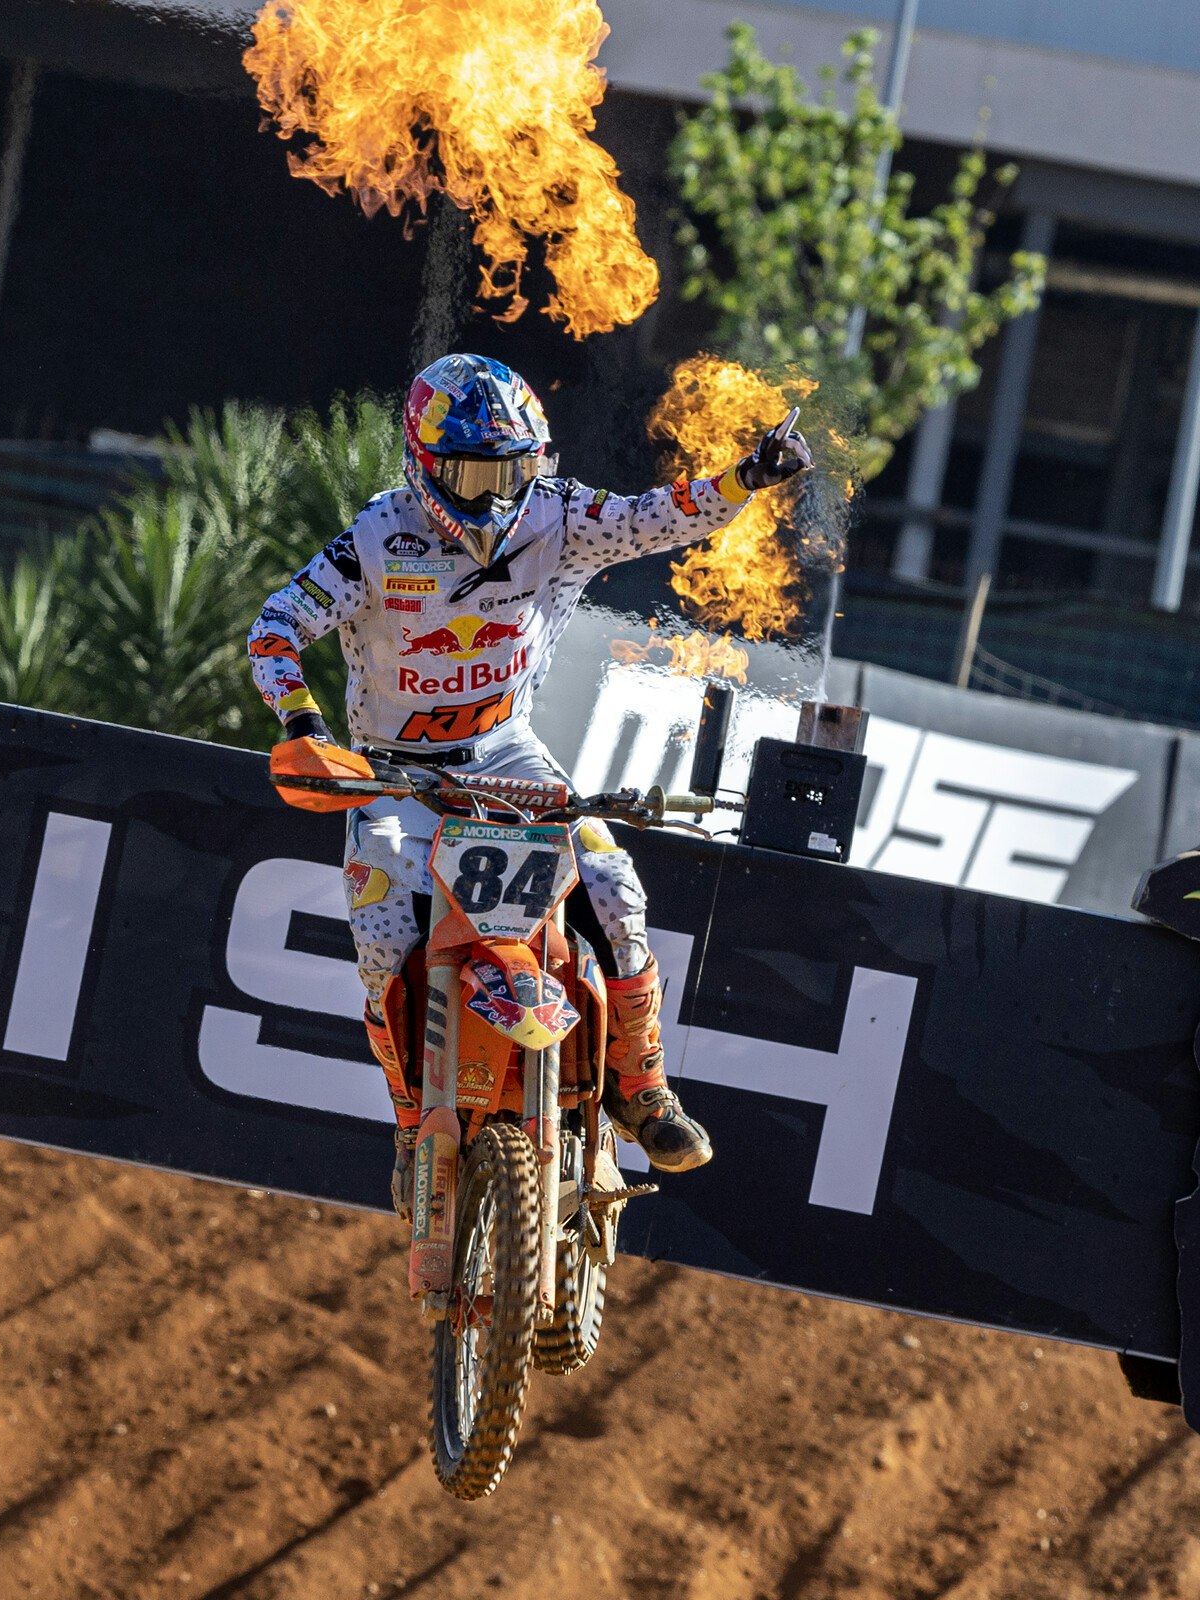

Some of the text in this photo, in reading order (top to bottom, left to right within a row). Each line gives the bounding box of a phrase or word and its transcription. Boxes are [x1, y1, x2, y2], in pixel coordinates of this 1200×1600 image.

[389, 535, 425, 552] Airoh
[401, 560, 453, 573] MOTOREX
[386, 578, 435, 592] PIRELLI
[498, 590, 535, 606] RAM
[399, 646, 527, 695] Red Bull
[395, 688, 517, 743] KTM
[463, 825, 529, 840] MOTOREX
[452, 845, 560, 919] 84
[493, 924, 531, 934] COMISA
[415, 1164, 429, 1237] MOTOREX
